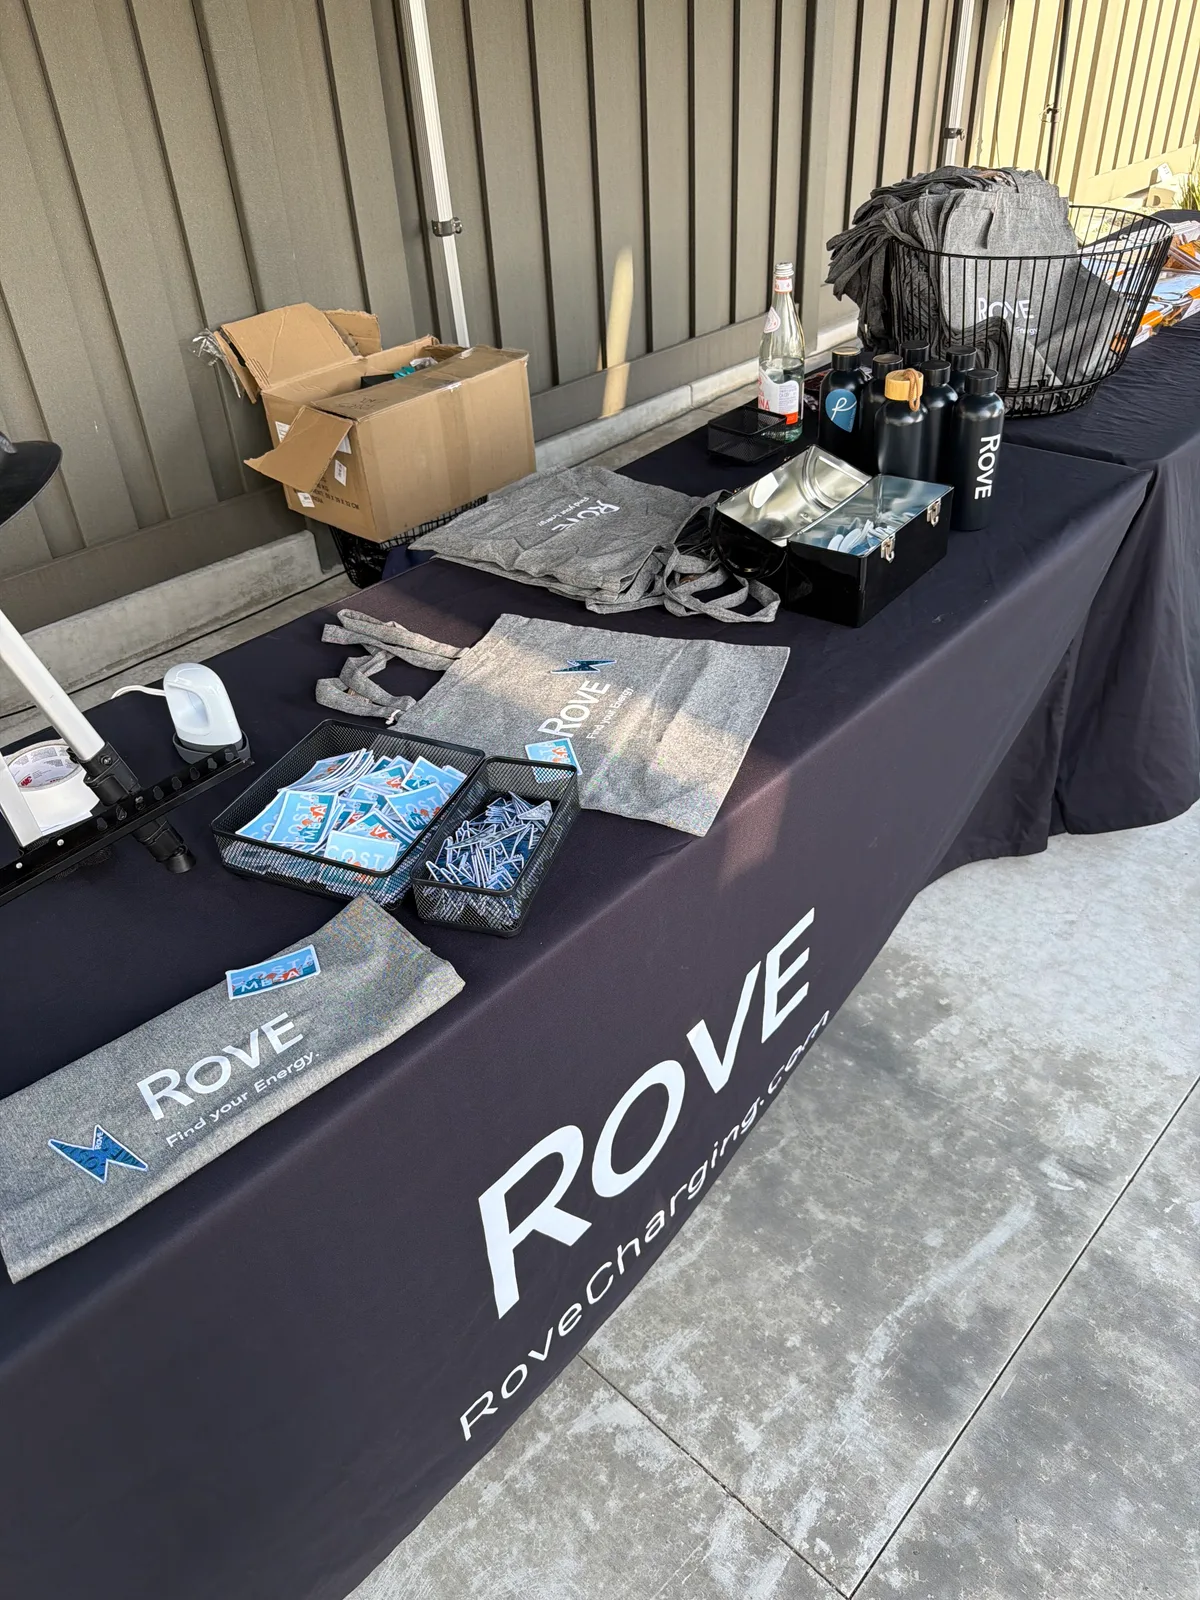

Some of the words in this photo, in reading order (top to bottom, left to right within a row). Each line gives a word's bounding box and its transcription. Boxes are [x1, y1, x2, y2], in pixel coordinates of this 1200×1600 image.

[974, 433, 1001, 500] ROVE
[537, 680, 611, 738] ROVE
[231, 954, 315, 987] COSTA
[240, 970, 301, 993] MESA
[136, 1012, 304, 1121] ROVE
[166, 1117, 207, 1148] Find
[209, 1091, 249, 1123] your
[253, 1051, 320, 1094] Energy.
[478, 907, 814, 1319] ROVE
[459, 1010, 829, 1441] RoveCharging.com
